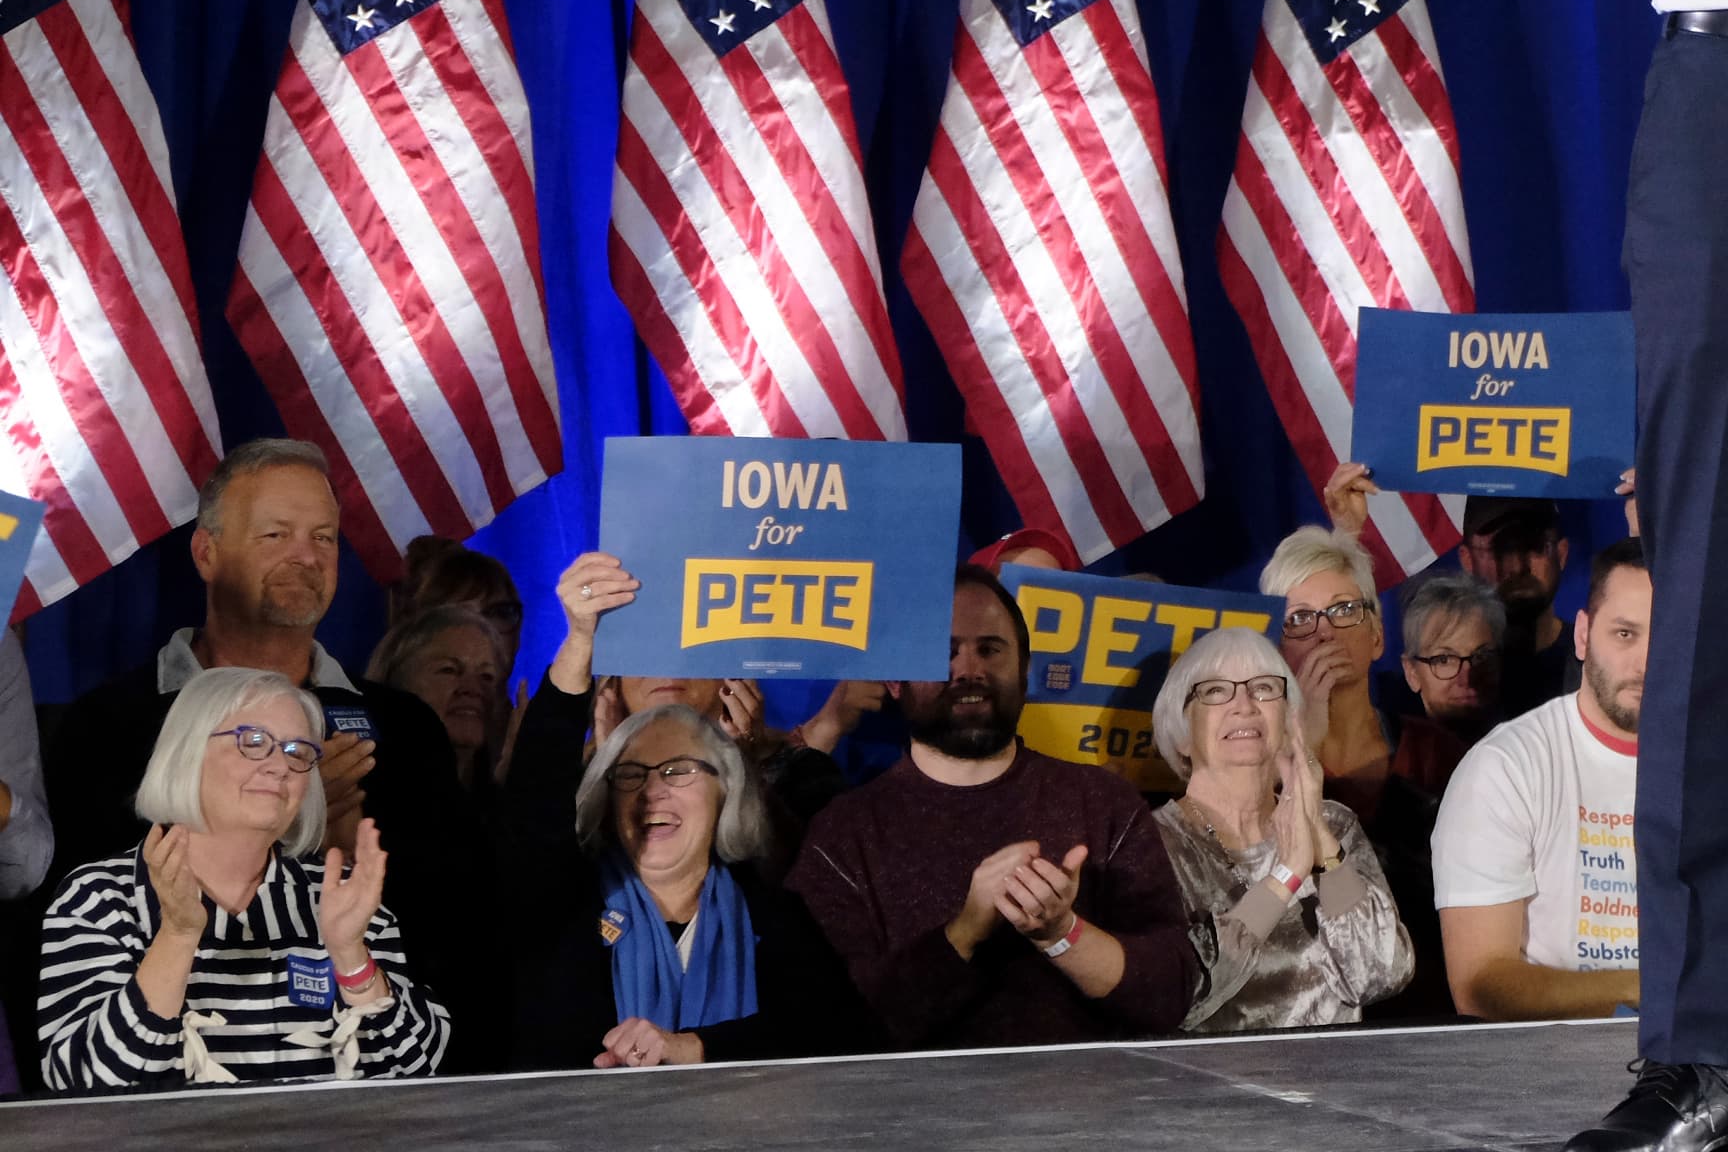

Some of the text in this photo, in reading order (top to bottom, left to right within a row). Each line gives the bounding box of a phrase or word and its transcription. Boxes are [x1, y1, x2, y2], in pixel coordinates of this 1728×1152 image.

[1449, 332, 1548, 369] IOWA
[1470, 373, 1515, 400] for
[1429, 416, 1559, 460] PETE
[722, 460, 848, 511] IOWA
[748, 516, 804, 551] for
[695, 573, 860, 631] PETE
[1014, 584, 1272, 688] PET
[1078, 724, 1152, 759] 202
[1578, 826, 1635, 848] Belon
[1580, 850, 1625, 870] Truth
[295, 975, 327, 991] PETE
[299, 993, 325, 1005] 2020
